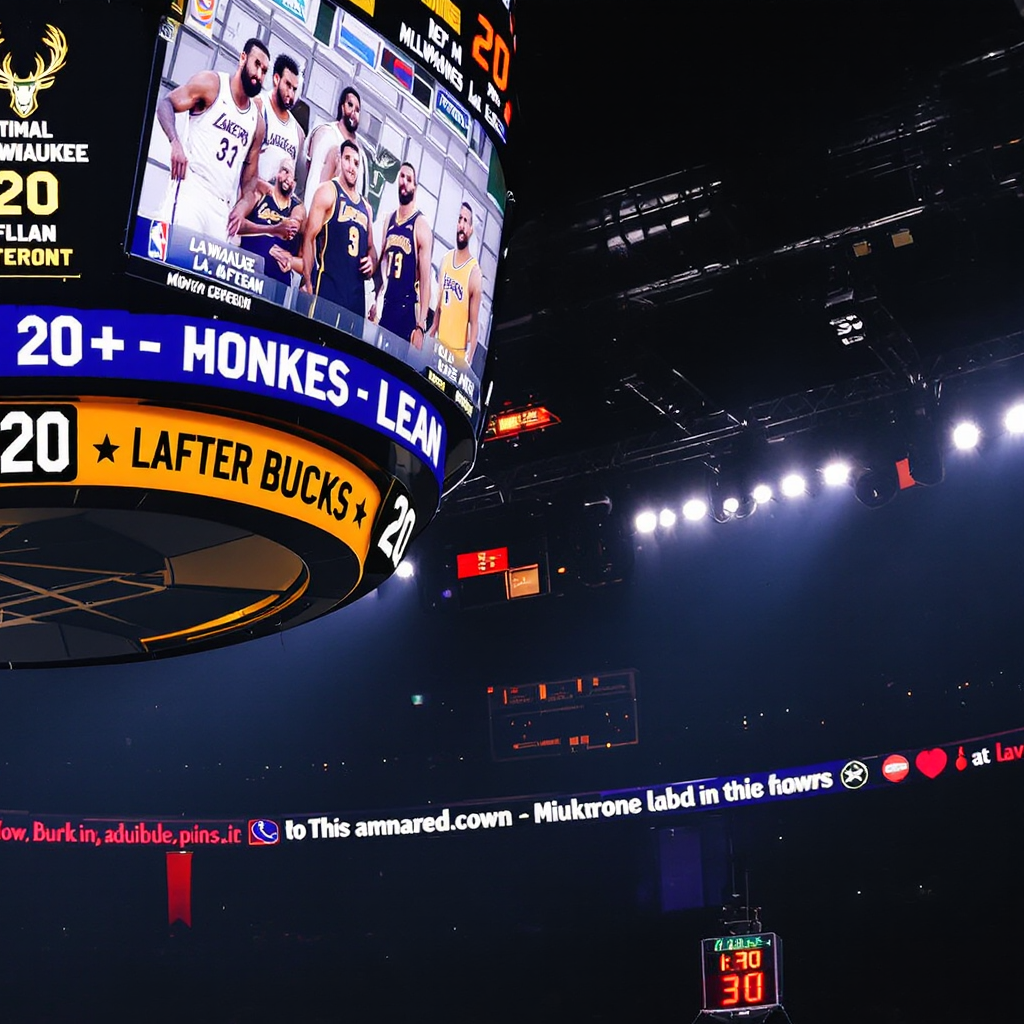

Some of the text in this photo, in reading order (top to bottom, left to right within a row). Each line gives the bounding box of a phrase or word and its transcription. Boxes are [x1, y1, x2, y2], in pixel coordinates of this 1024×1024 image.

[472, 13, 510, 91] 20
[0, 411, 70, 475] 20
[132, 426, 252, 486] LAFTER
[260, 454, 353, 522] BUCKS
[377, 495, 416, 568] 20
[971, 748, 991, 767] at
[308, 815, 351, 839] This
[700, 786, 719, 806] in
[722, 972, 764, 1006] 30
